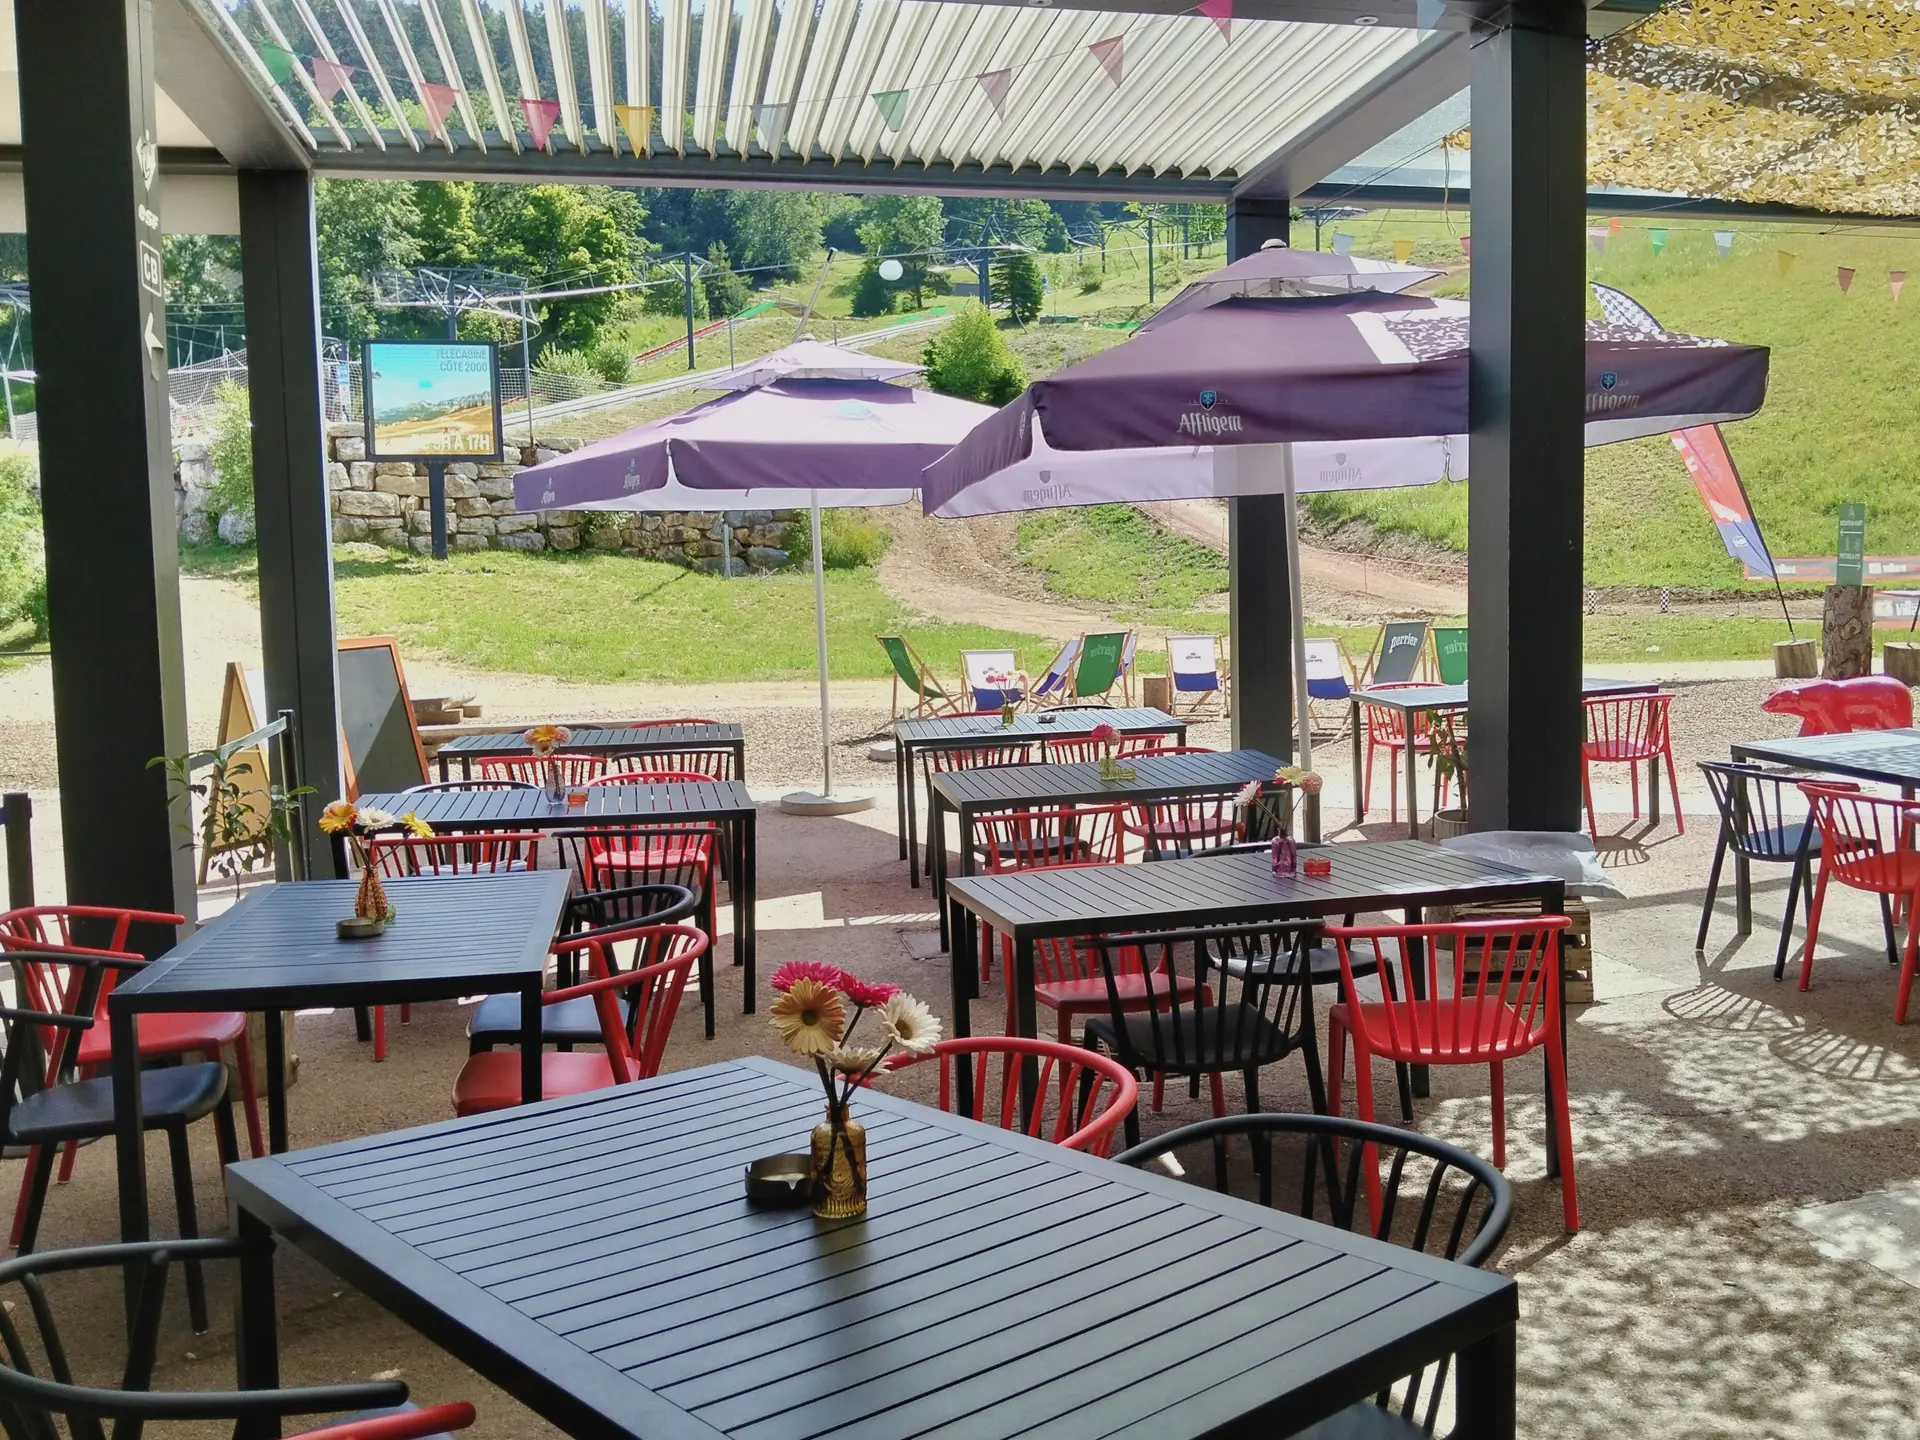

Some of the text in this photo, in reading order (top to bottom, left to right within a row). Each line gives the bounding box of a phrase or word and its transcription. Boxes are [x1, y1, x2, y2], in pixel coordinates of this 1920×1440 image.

[143, 253, 158, 285] CB
[465, 362, 488, 372] 2000
[1585, 392, 1640, 412] ffligem
[1176, 413, 1243, 436] Affligem
